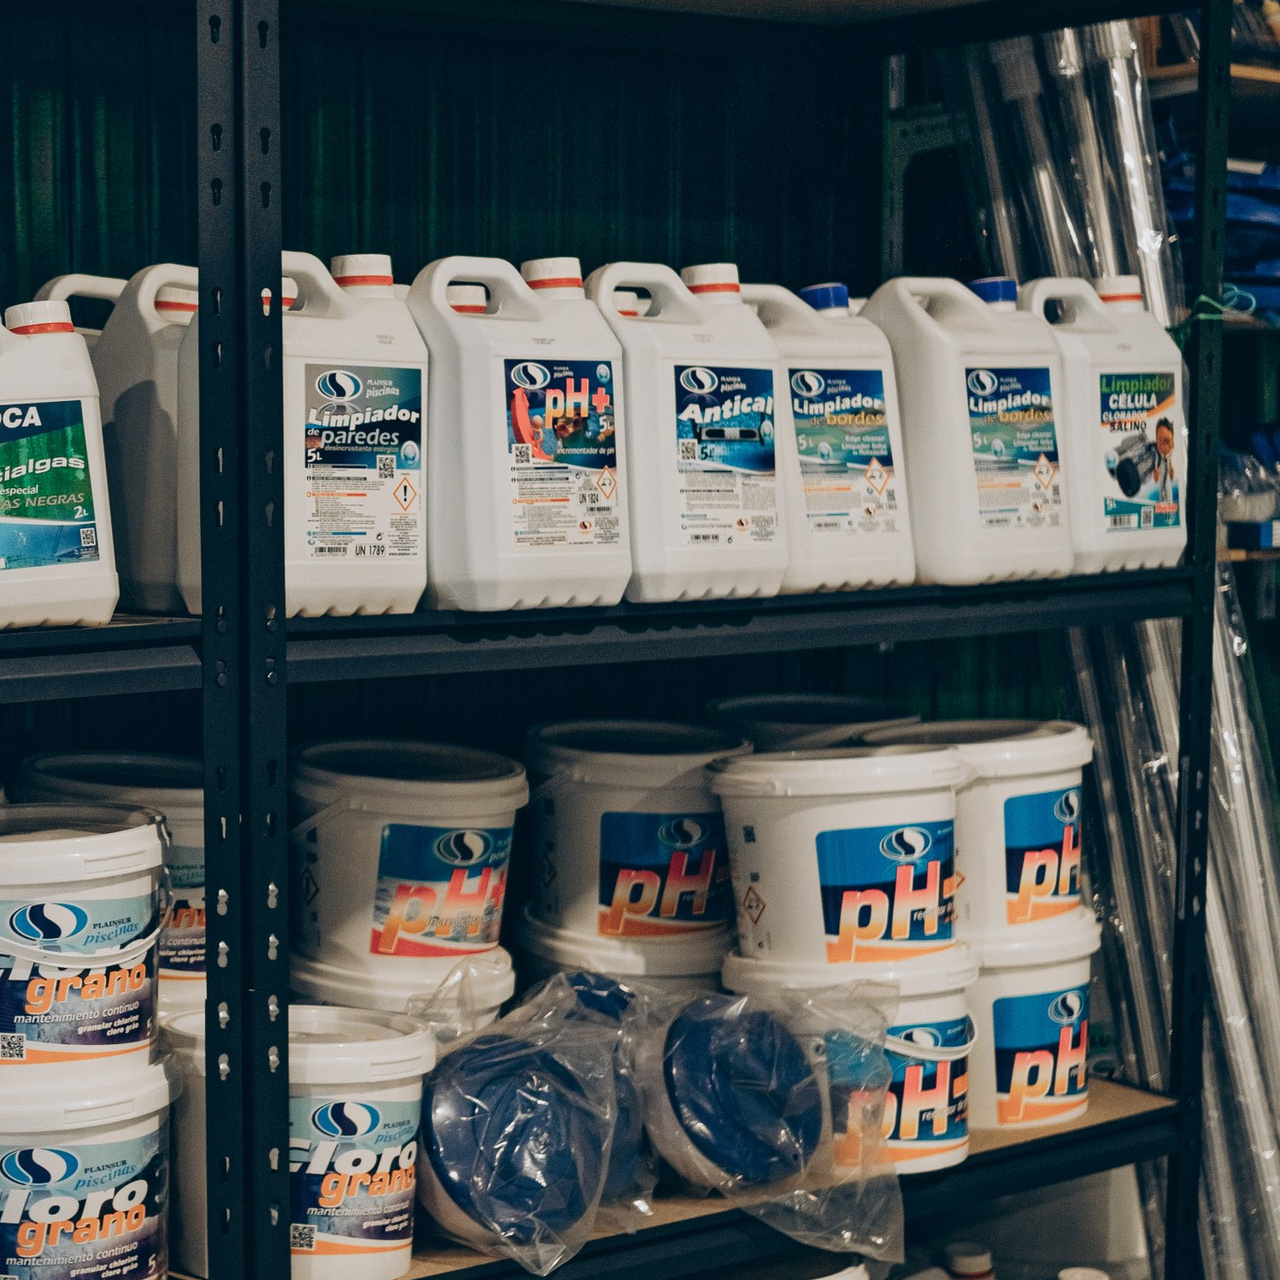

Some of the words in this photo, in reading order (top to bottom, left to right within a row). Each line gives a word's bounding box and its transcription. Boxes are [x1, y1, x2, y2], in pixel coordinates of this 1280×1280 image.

[1101, 377, 1171, 393] Limpiador
[545, 377, 610, 428] pH+
[793, 393, 883, 414] Limpiador
[970, 391, 1050, 413] Limpiador
[1109, 390, 1157, 409] CÉLULA
[307, 404, 420, 430] Limpiador
[825, 412, 885, 426] bordes
[999, 410, 1051, 422] bordes
[1109, 422, 1147, 432] SALINO
[307, 428, 320, 437] de
[320, 428, 399, 448] paredes
[0, 484, 39, 496] especial
[25, 493, 84, 508] NEGRAS
[588, 493, 600, 504] 1824
[355, 545, 367, 556] UN
[368, 545, 385, 557] 1789
[24, 964, 146, 1014] grano
[13, 1010, 99, 1025] mantenimiento
[77, 1020, 112, 1035] granular
[73, 1164, 136, 1191] piscinas
[318, 1165, 416, 1208] grano
[16, 1203, 146, 1257] grano
[6, 1252, 94, 1267] mantenimiento
[70, 1262, 107, 1278] granular
